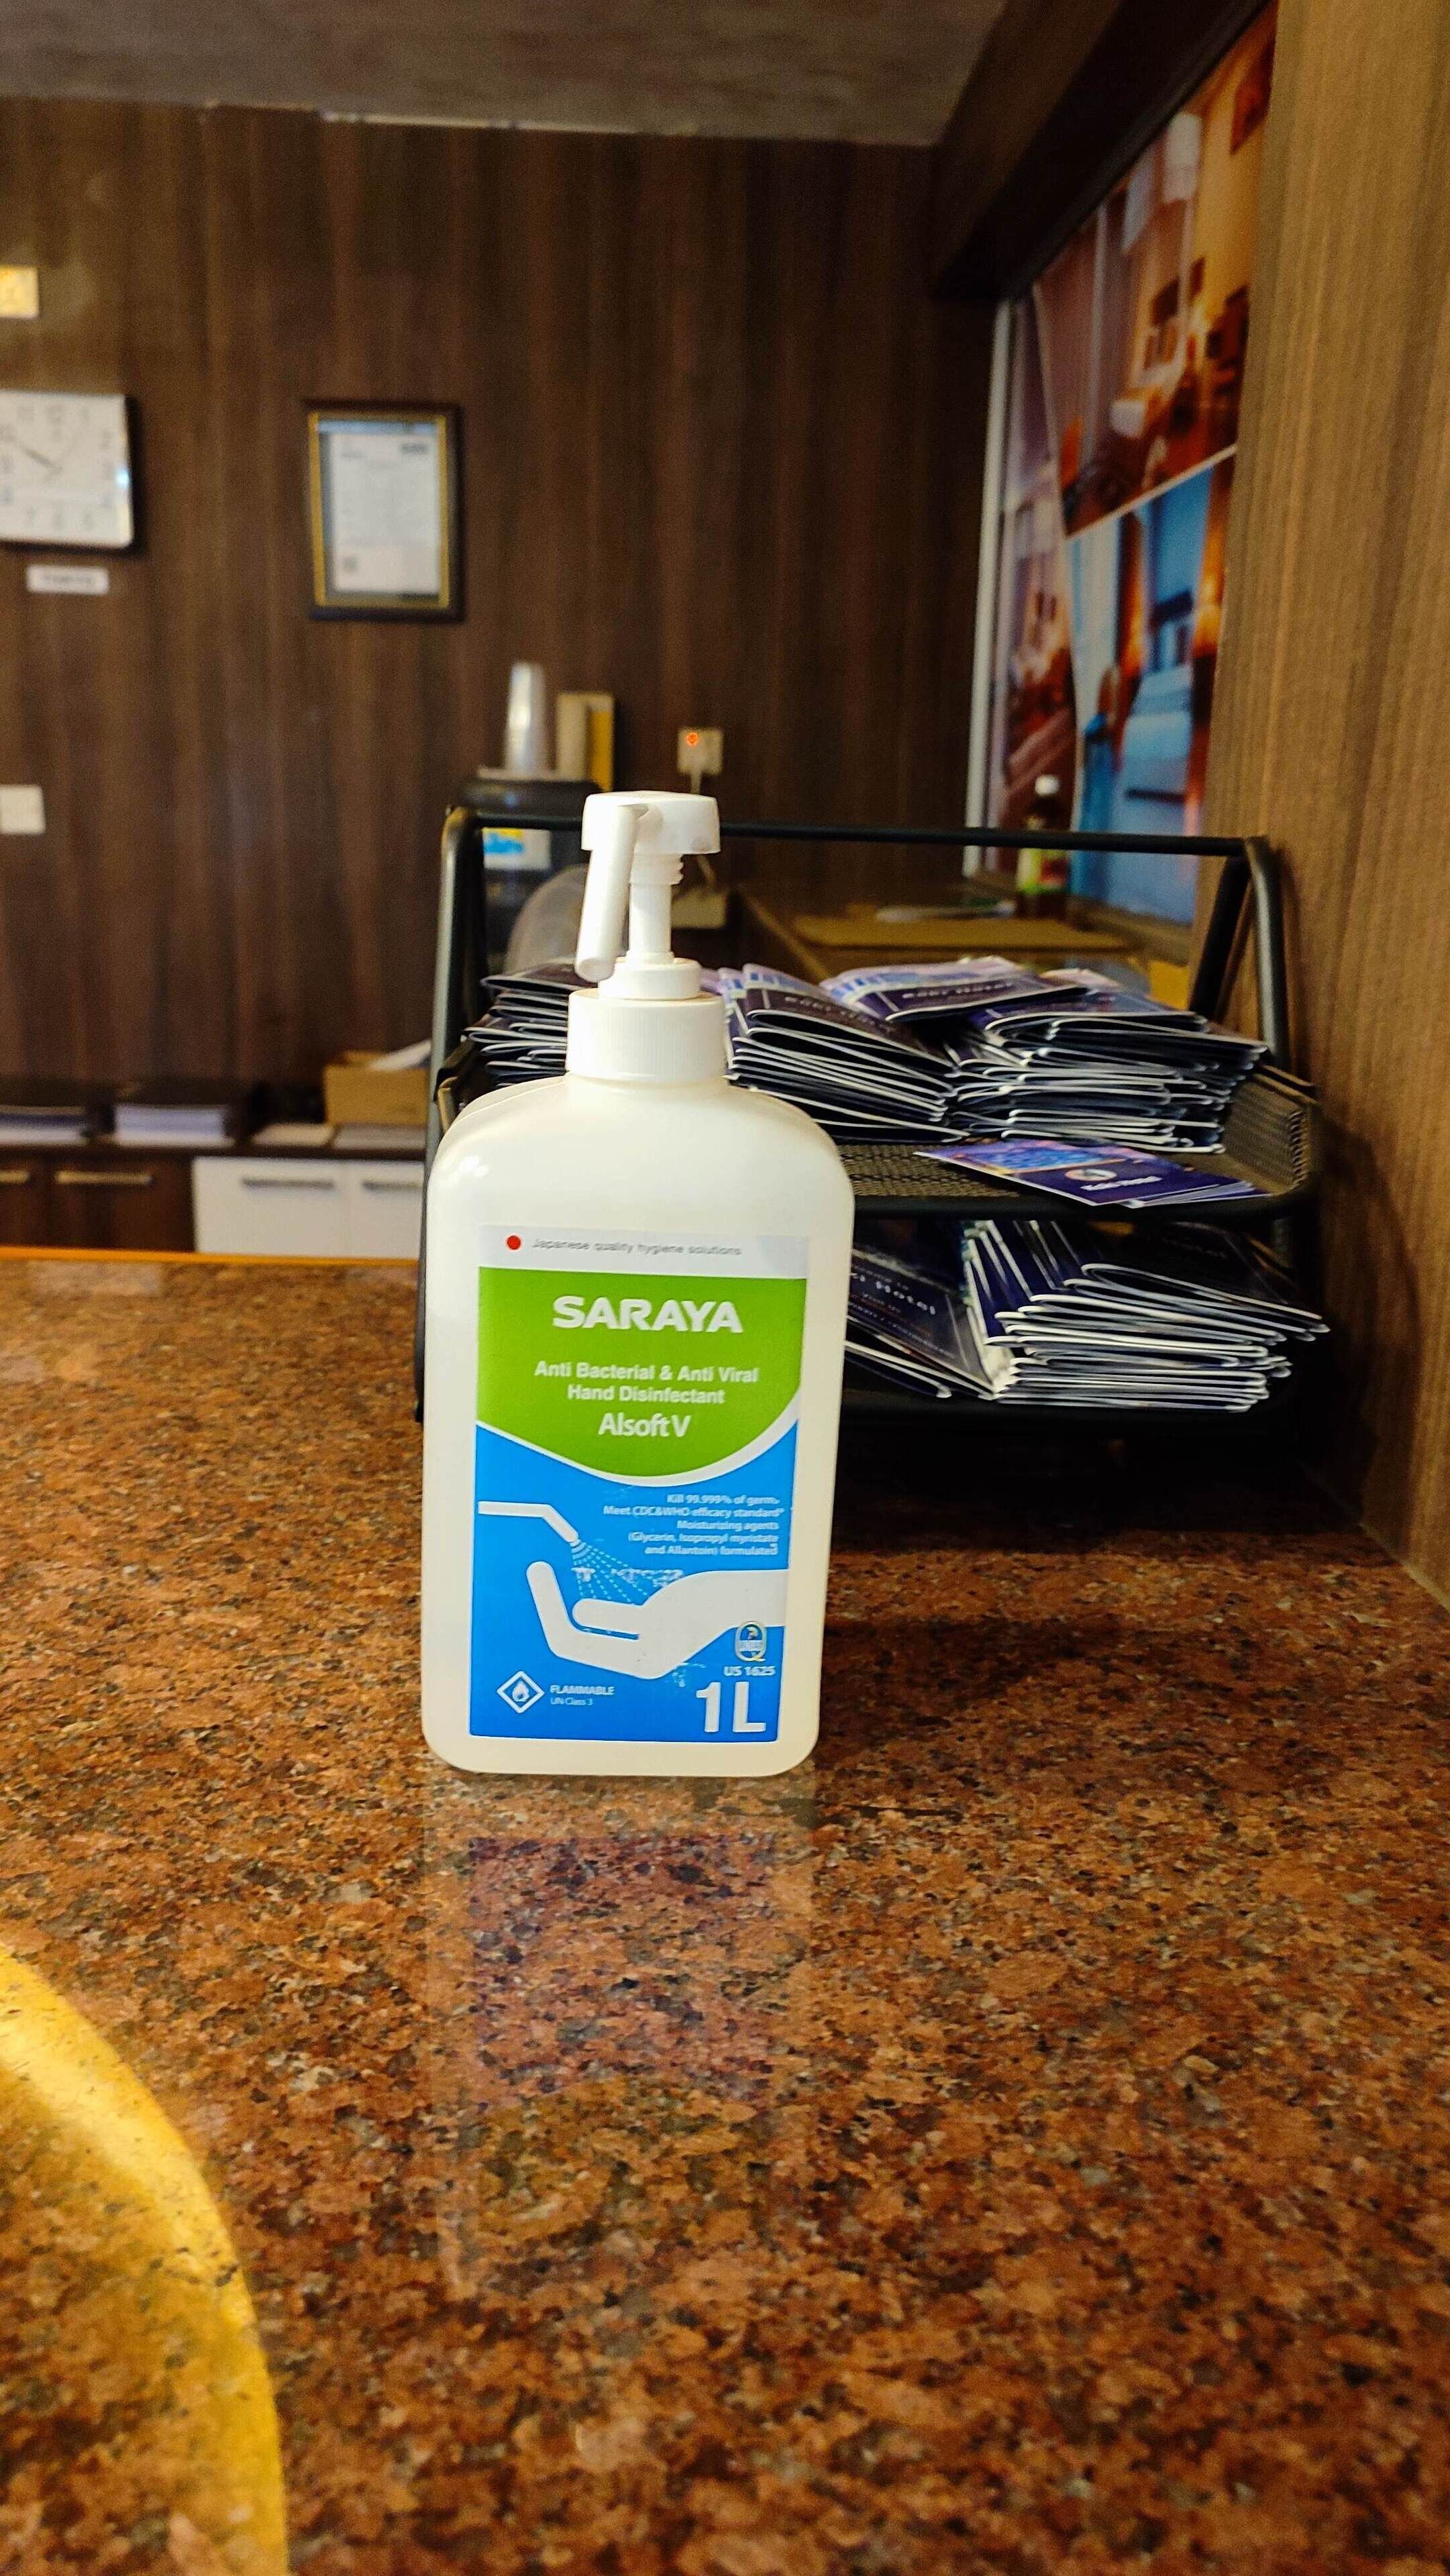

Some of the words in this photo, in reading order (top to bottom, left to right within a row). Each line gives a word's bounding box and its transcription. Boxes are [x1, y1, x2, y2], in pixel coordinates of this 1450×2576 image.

[553, 1295, 743, 1333] SARAYA
[534, 1360, 571, 1377] Anti
[576, 1362, 655, 1381] Bacterial
[659, 1364, 672, 1381] &
[677, 1365, 714, 1382] Anti
[718, 1366, 760, 1383] Viral
[567, 1384, 615, 1401] Hand
[619, 1385, 725, 1404] Disinfectant
[733, 1495, 746, 1504] of
[603, 1505, 631, 1515] Meet
[691, 1507, 732, 1519] efficacy
[743, 1522, 779, 1532] agents
[645, 1545, 666, 1554] and
[724, 1666, 742, 1676] US
[550, 1684, 615, 1695] FLAMMABLE
